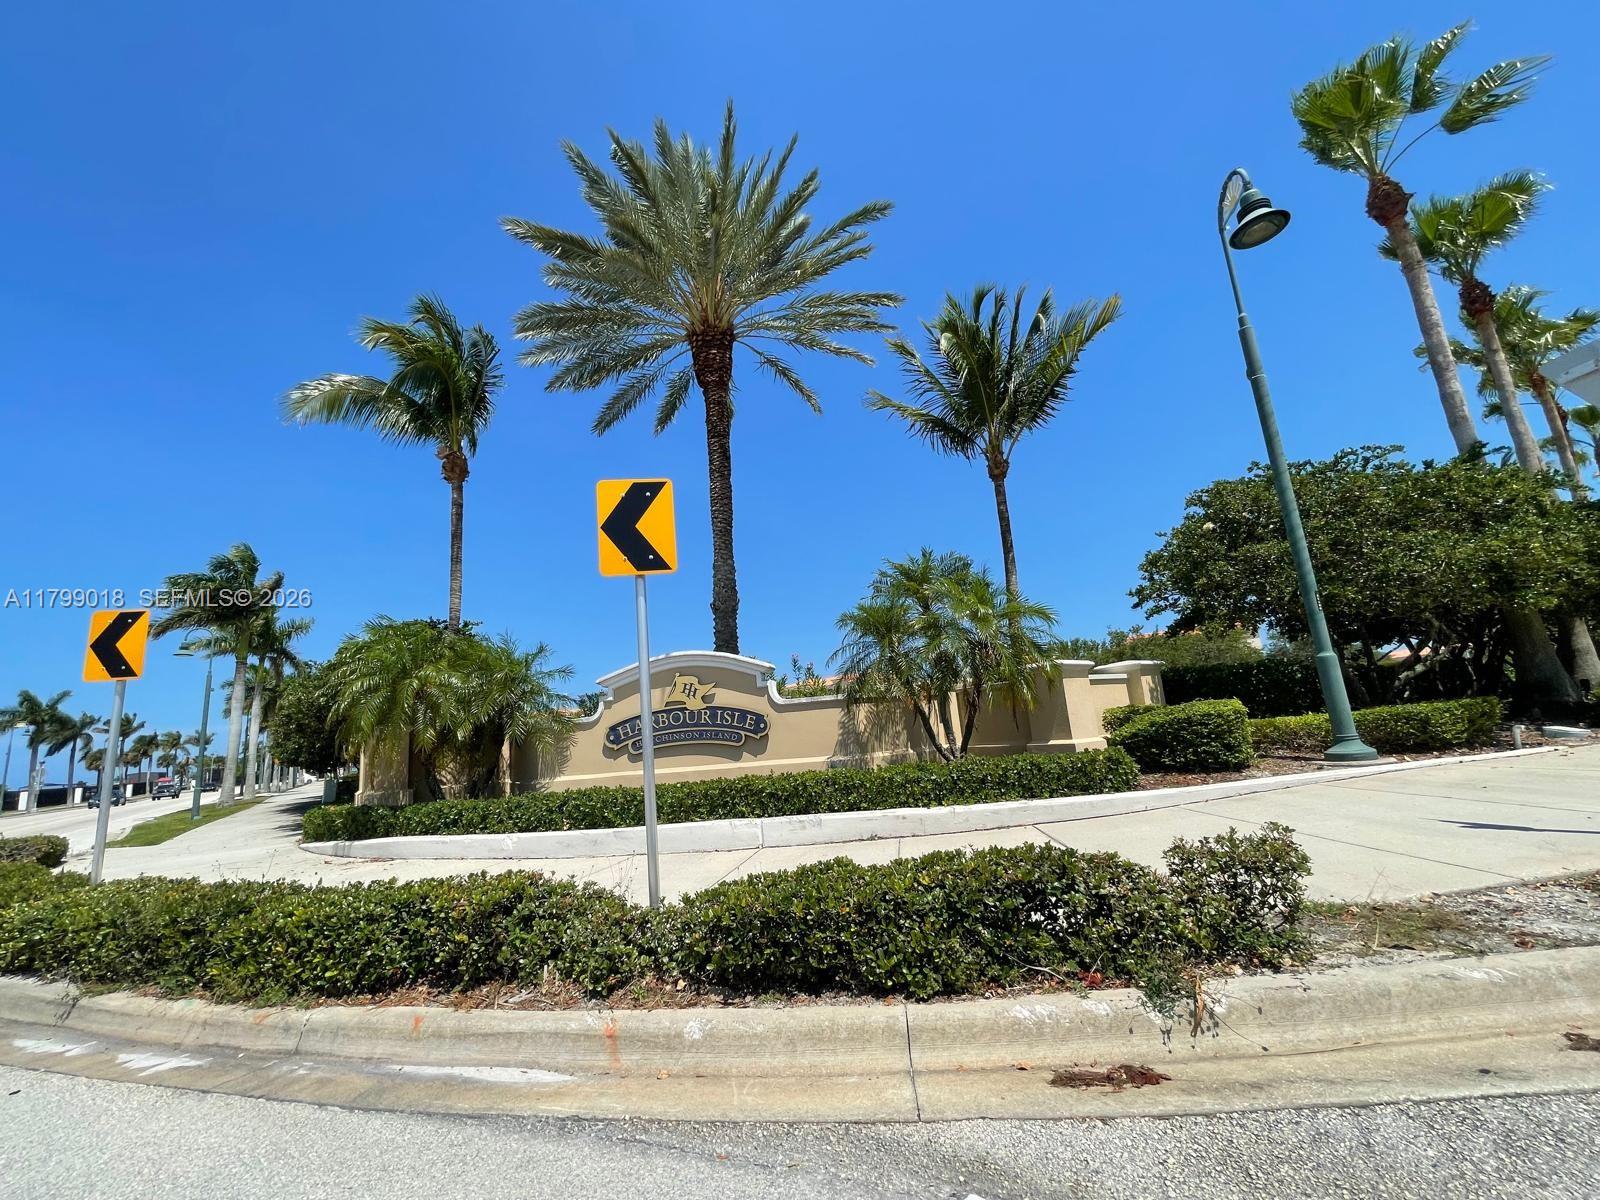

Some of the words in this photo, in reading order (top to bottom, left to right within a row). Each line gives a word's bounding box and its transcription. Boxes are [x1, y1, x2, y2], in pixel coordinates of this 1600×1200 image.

[716, 710, 756, 730] ISLE
[635, 732, 701, 748] HCHINSON
[703, 731, 738, 741] ISLAND
